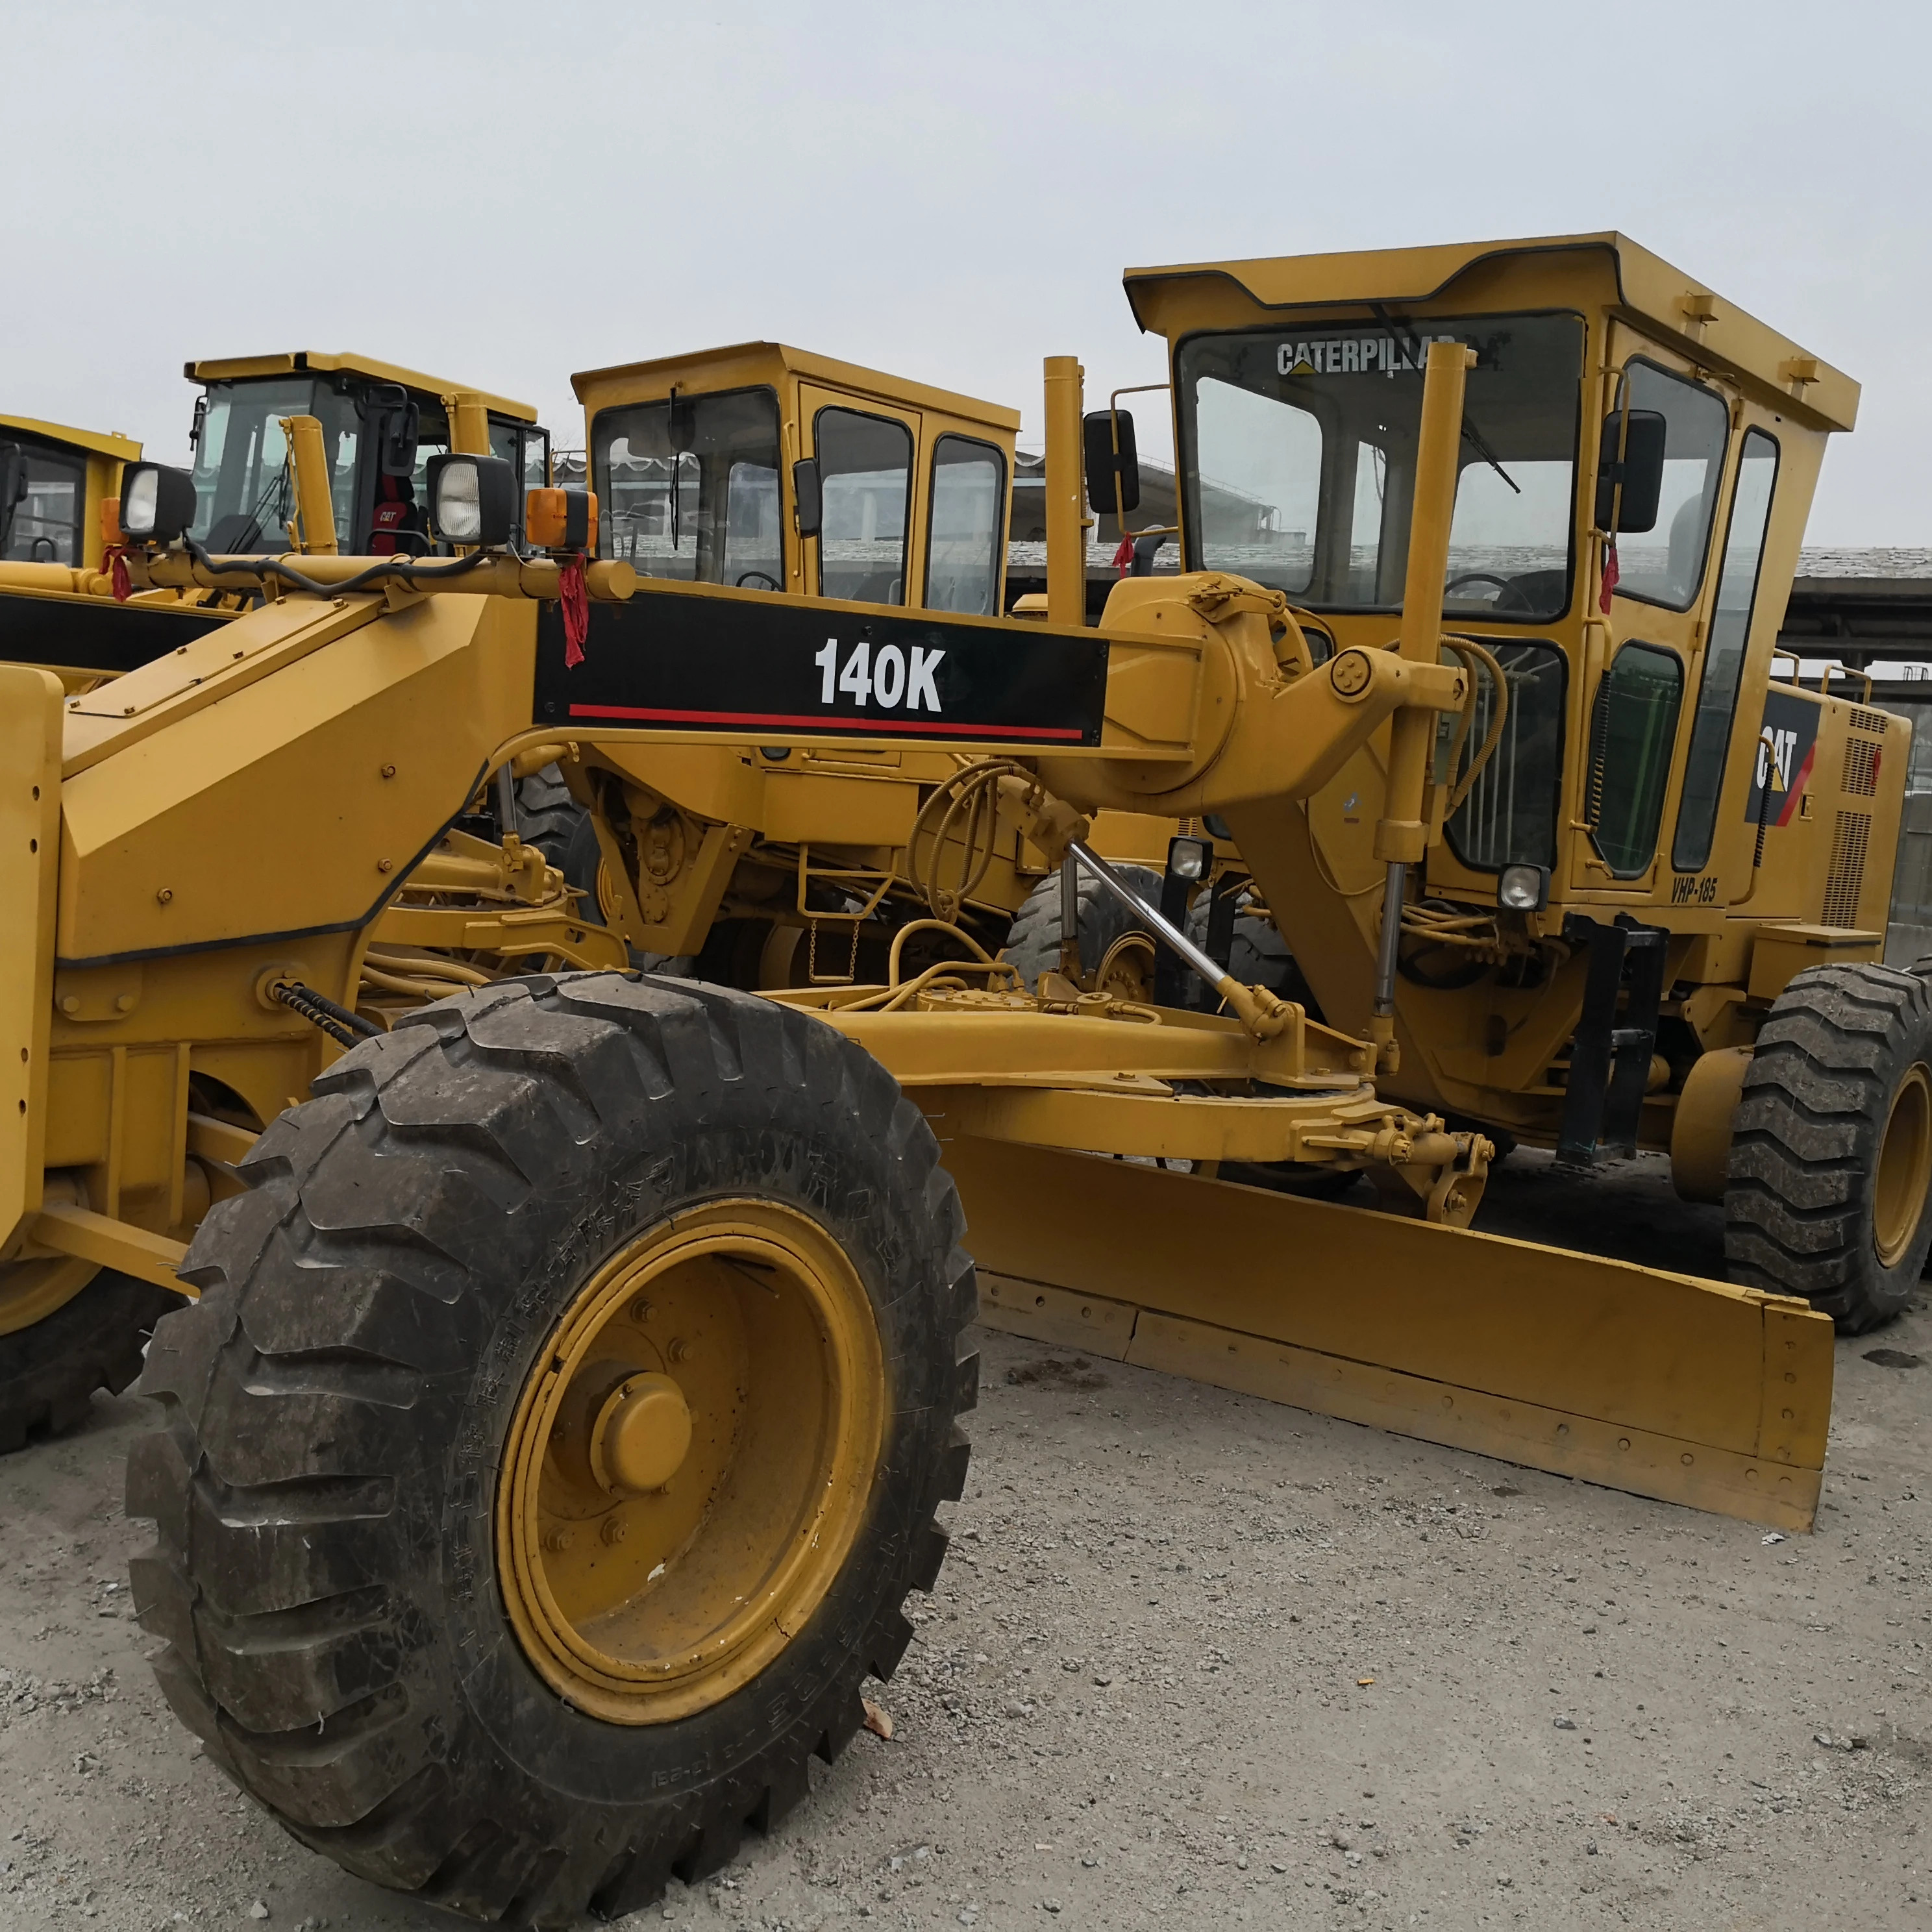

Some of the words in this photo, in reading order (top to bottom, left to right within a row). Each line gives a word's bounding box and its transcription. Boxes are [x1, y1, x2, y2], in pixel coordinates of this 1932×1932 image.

[1277, 336, 1455, 375] CATERPILLA
[380, 512, 397, 522] CAT
[815, 638, 947, 713] 140K
[1757, 726, 1798, 792] CAT
[1671, 877, 1718, 903] VHP-185
